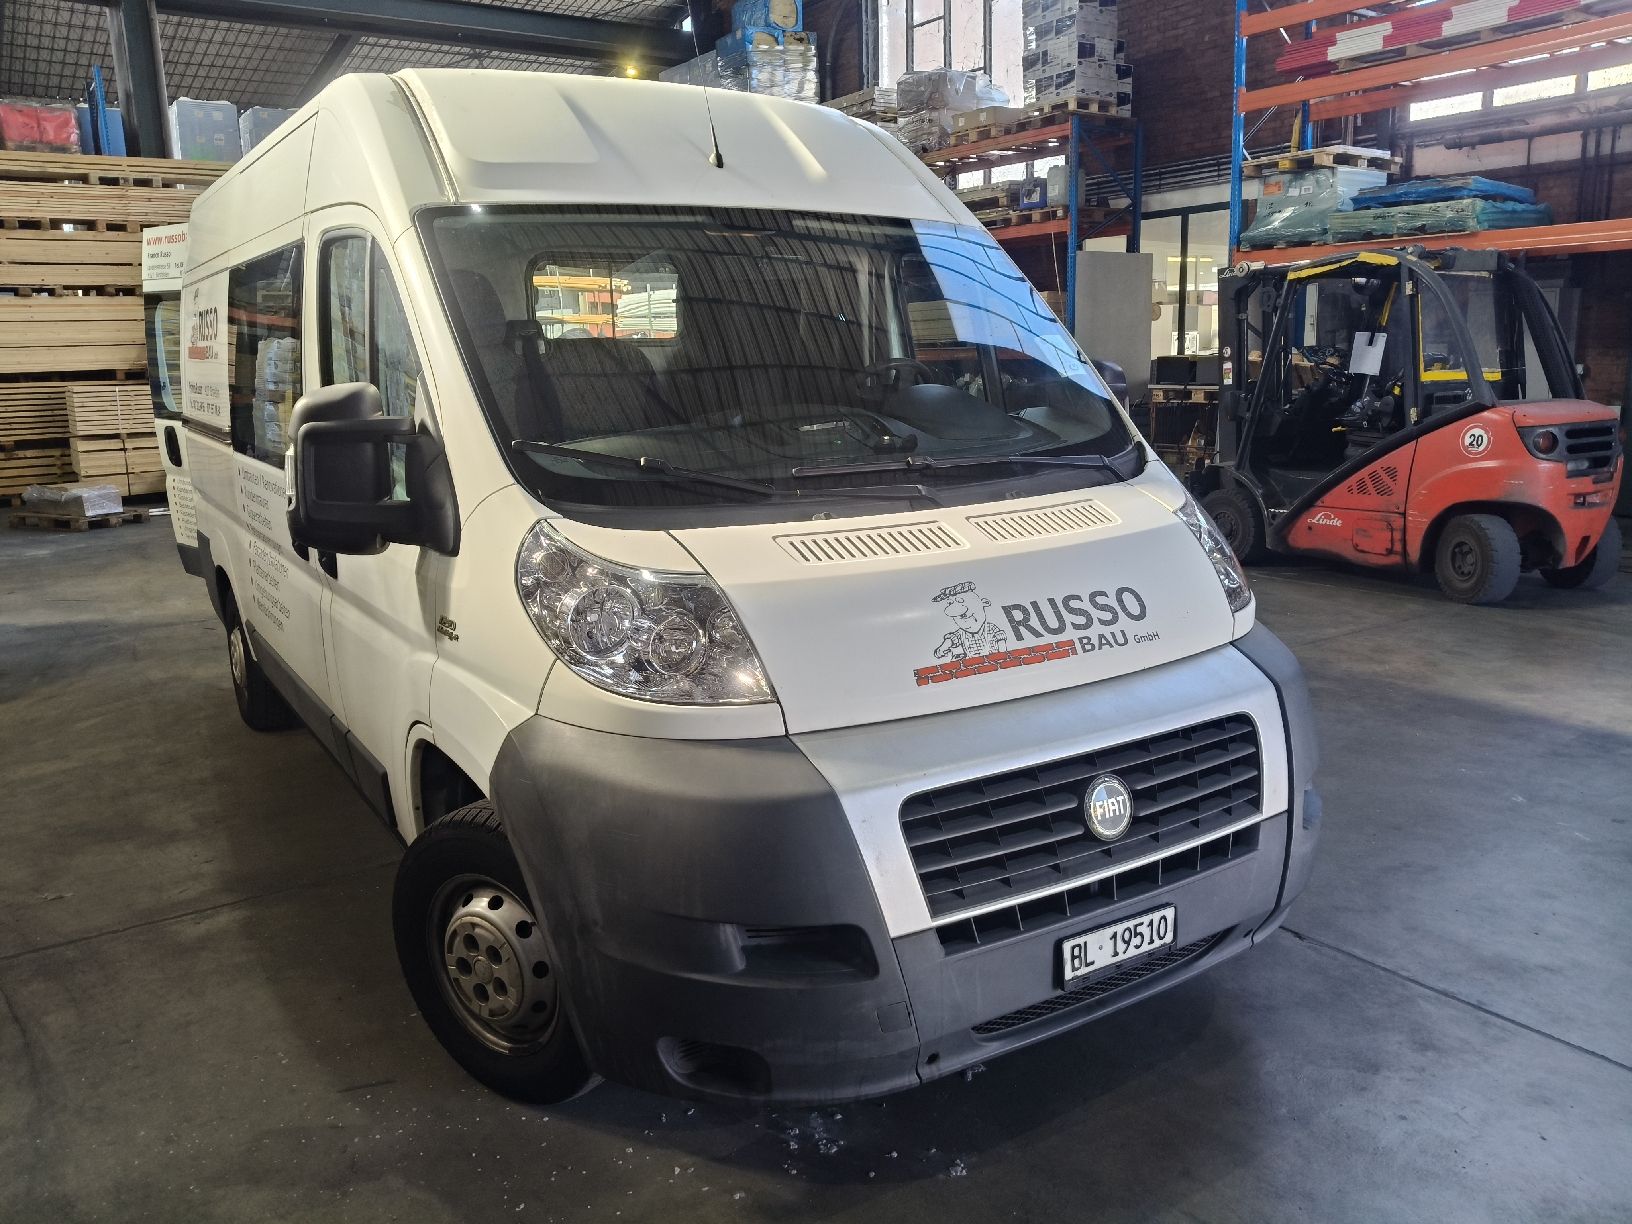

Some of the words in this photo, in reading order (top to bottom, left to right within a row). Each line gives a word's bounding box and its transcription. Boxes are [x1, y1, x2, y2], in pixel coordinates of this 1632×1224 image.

[199, 307, 218, 341] RUSSO
[1469, 433, 1484, 448] 20
[1307, 511, 1343, 527] Linde
[1001, 586, 1147, 642] RUSSO
[1078, 629, 1130, 654] BAU
[1133, 631, 1161, 644] GmbH
[1095, 795, 1125, 821] FIAT
[1071, 940, 1096, 973] BL
[1109, 914, 1168, 958] 19510
